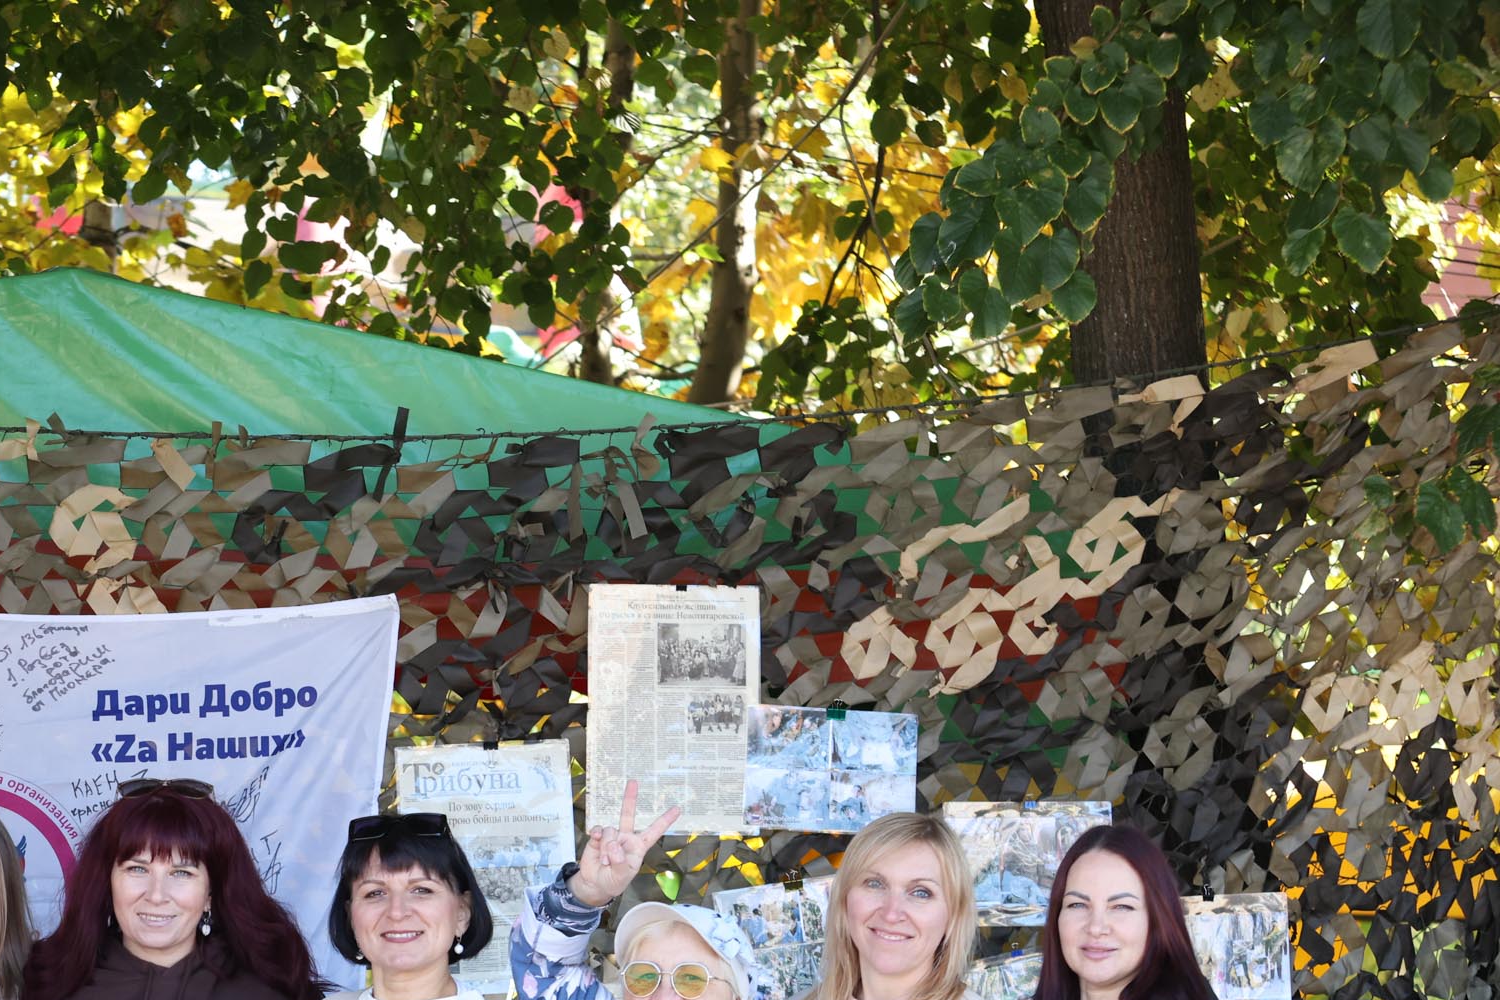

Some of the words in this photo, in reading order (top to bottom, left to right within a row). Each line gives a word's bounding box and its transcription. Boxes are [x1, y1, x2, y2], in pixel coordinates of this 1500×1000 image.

[92, 690, 190, 722] Дари
[199, 681, 318, 718] Добро
[167, 729, 306, 762] Наших»
[402, 762, 522, 799] Трибуна
[7, 779, 78, 840] организация
